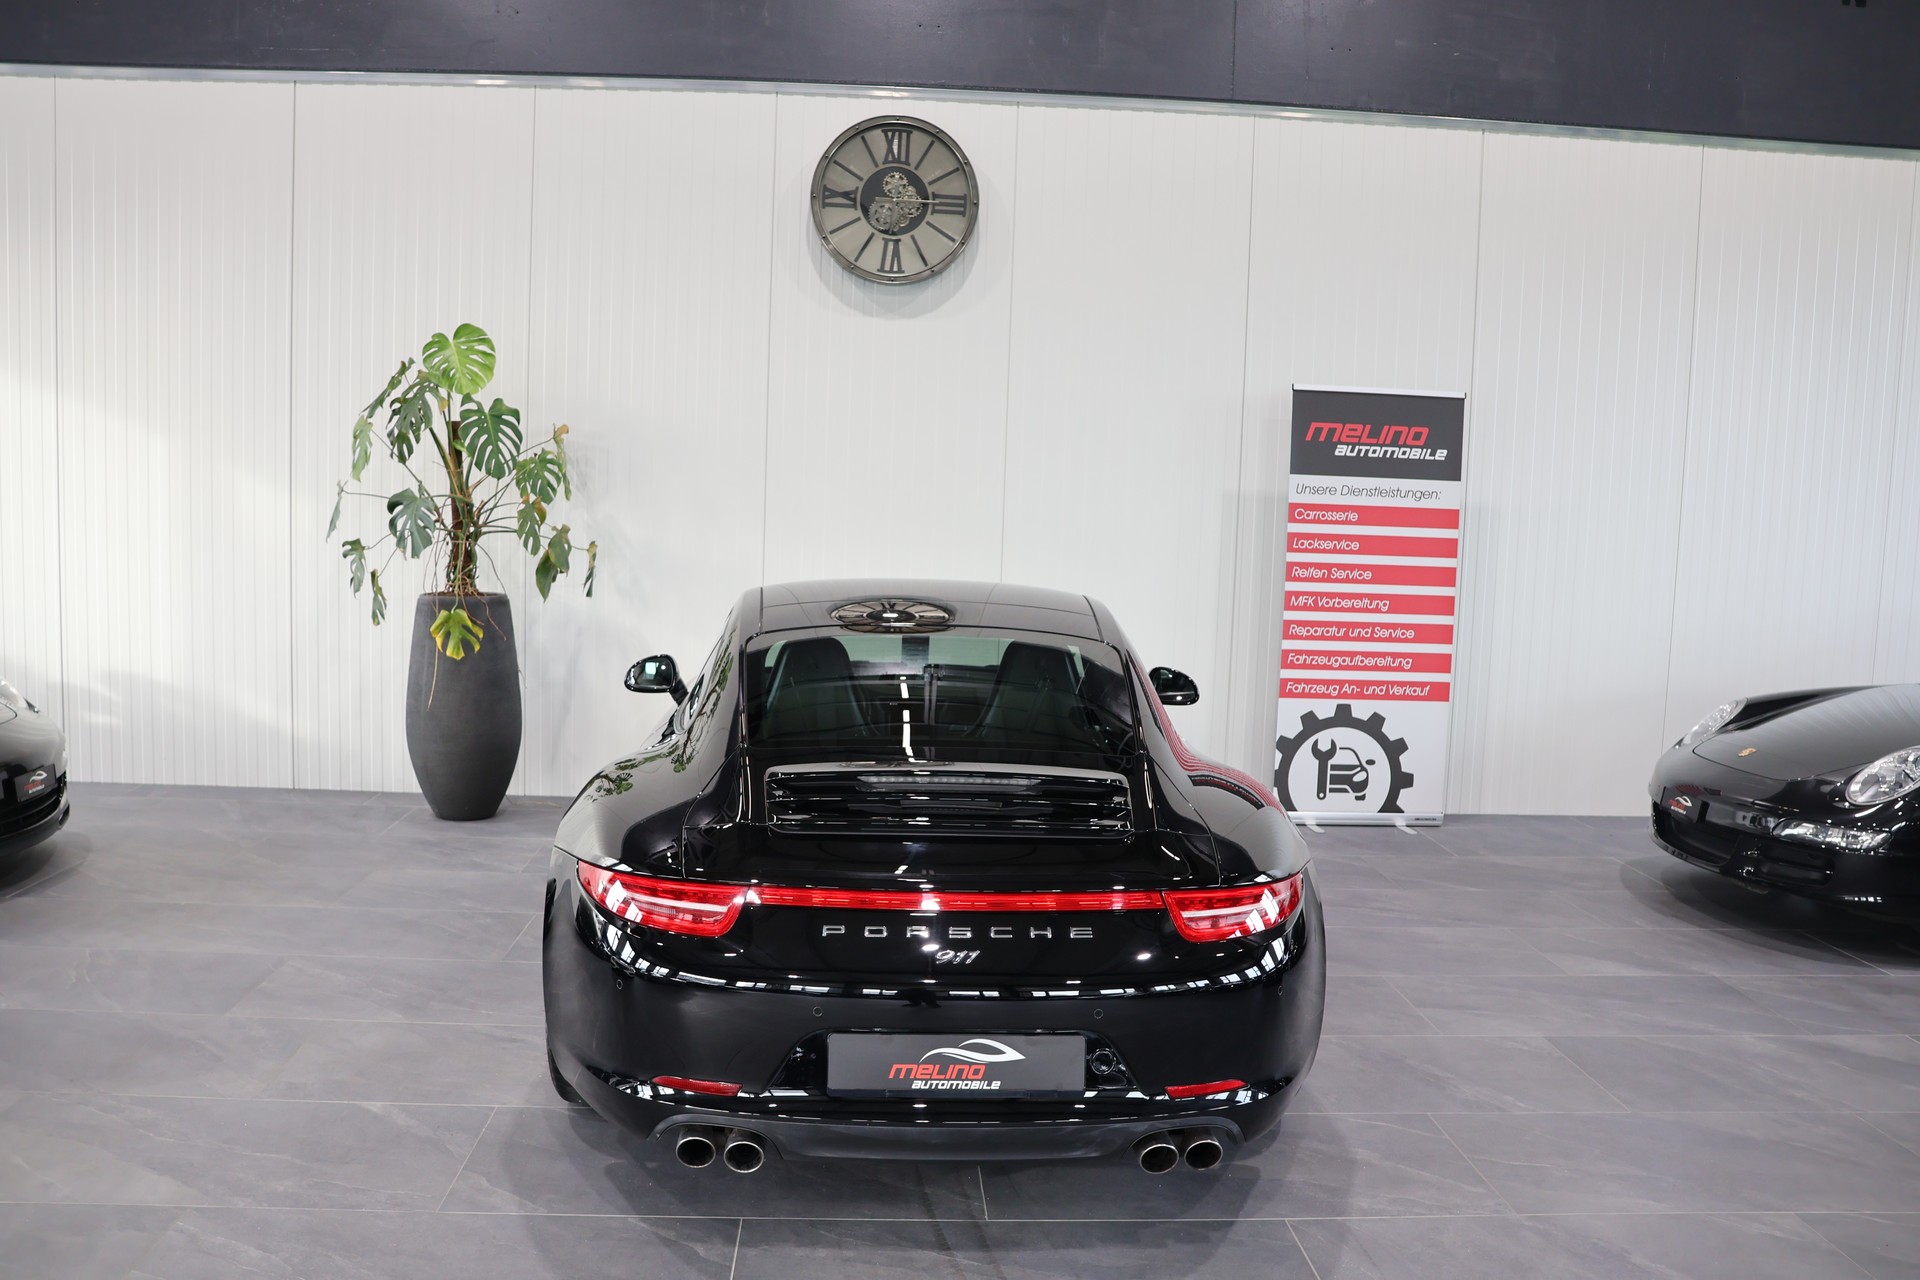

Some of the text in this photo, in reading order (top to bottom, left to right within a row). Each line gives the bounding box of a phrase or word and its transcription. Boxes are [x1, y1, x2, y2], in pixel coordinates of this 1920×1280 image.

[881, 128, 913, 166] XII
[1296, 483, 1442, 501] Unsere Dienstleistungen:
[1294, 508, 1358, 521] Carrosserie
[1292, 537, 1360, 550] Lackservice
[1291, 566, 1372, 580] Reifen Service
[1290, 595, 1390, 611] MFK Vorbereitung
[1288, 624, 1415, 639] Reparatur und Service
[1287, 653, 1413, 669] Fahrzeugaufbereitung
[1285, 682, 1431, 696] Fahrzeug An- und Verkauf
[821, 924, 1093, 939] PORSCHE
[935, 949, 980, 964] 911
